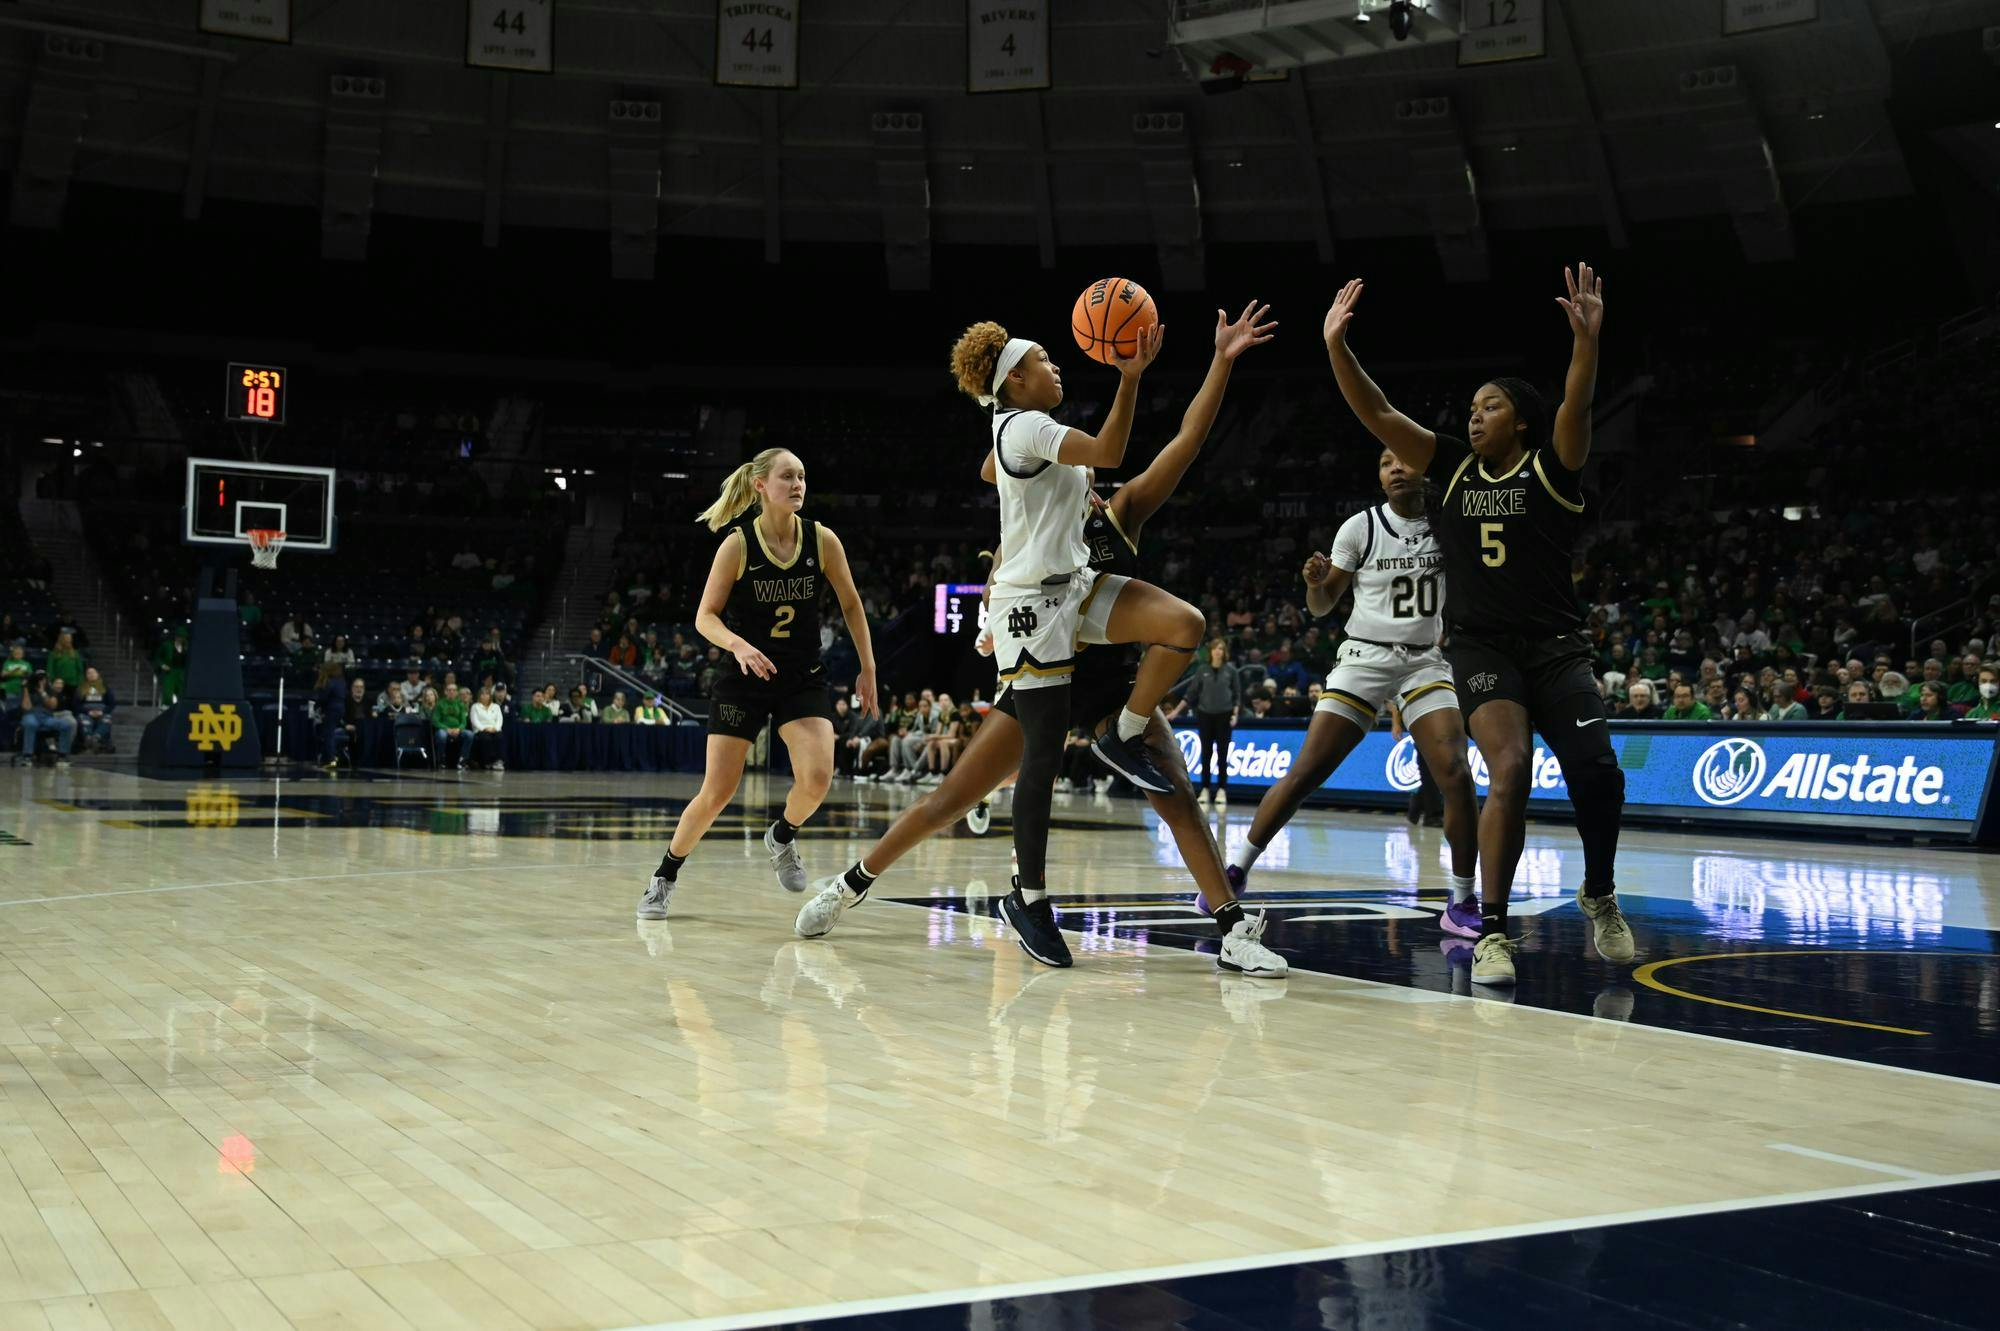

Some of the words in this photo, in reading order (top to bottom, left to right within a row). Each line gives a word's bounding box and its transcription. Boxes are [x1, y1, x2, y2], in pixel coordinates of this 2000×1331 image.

[493, 9, 527, 35] 44
[980, 9, 1036, 24] RIVERS
[1487, 0, 1518, 28] 12
[741, 27, 774, 53] 44
[1001, 33, 1016, 57] 4
[242, 369, 280, 389] 2:57
[247, 388, 275, 418] 18
[1462, 488, 1526, 516] WAKE
[1480, 522, 1506, 567] 5
[1376, 557, 1415, 571] NOTRE
[753, 576, 815, 602] WAKE
[1391, 575, 1438, 618] 20
[770, 605, 796, 638] 2
